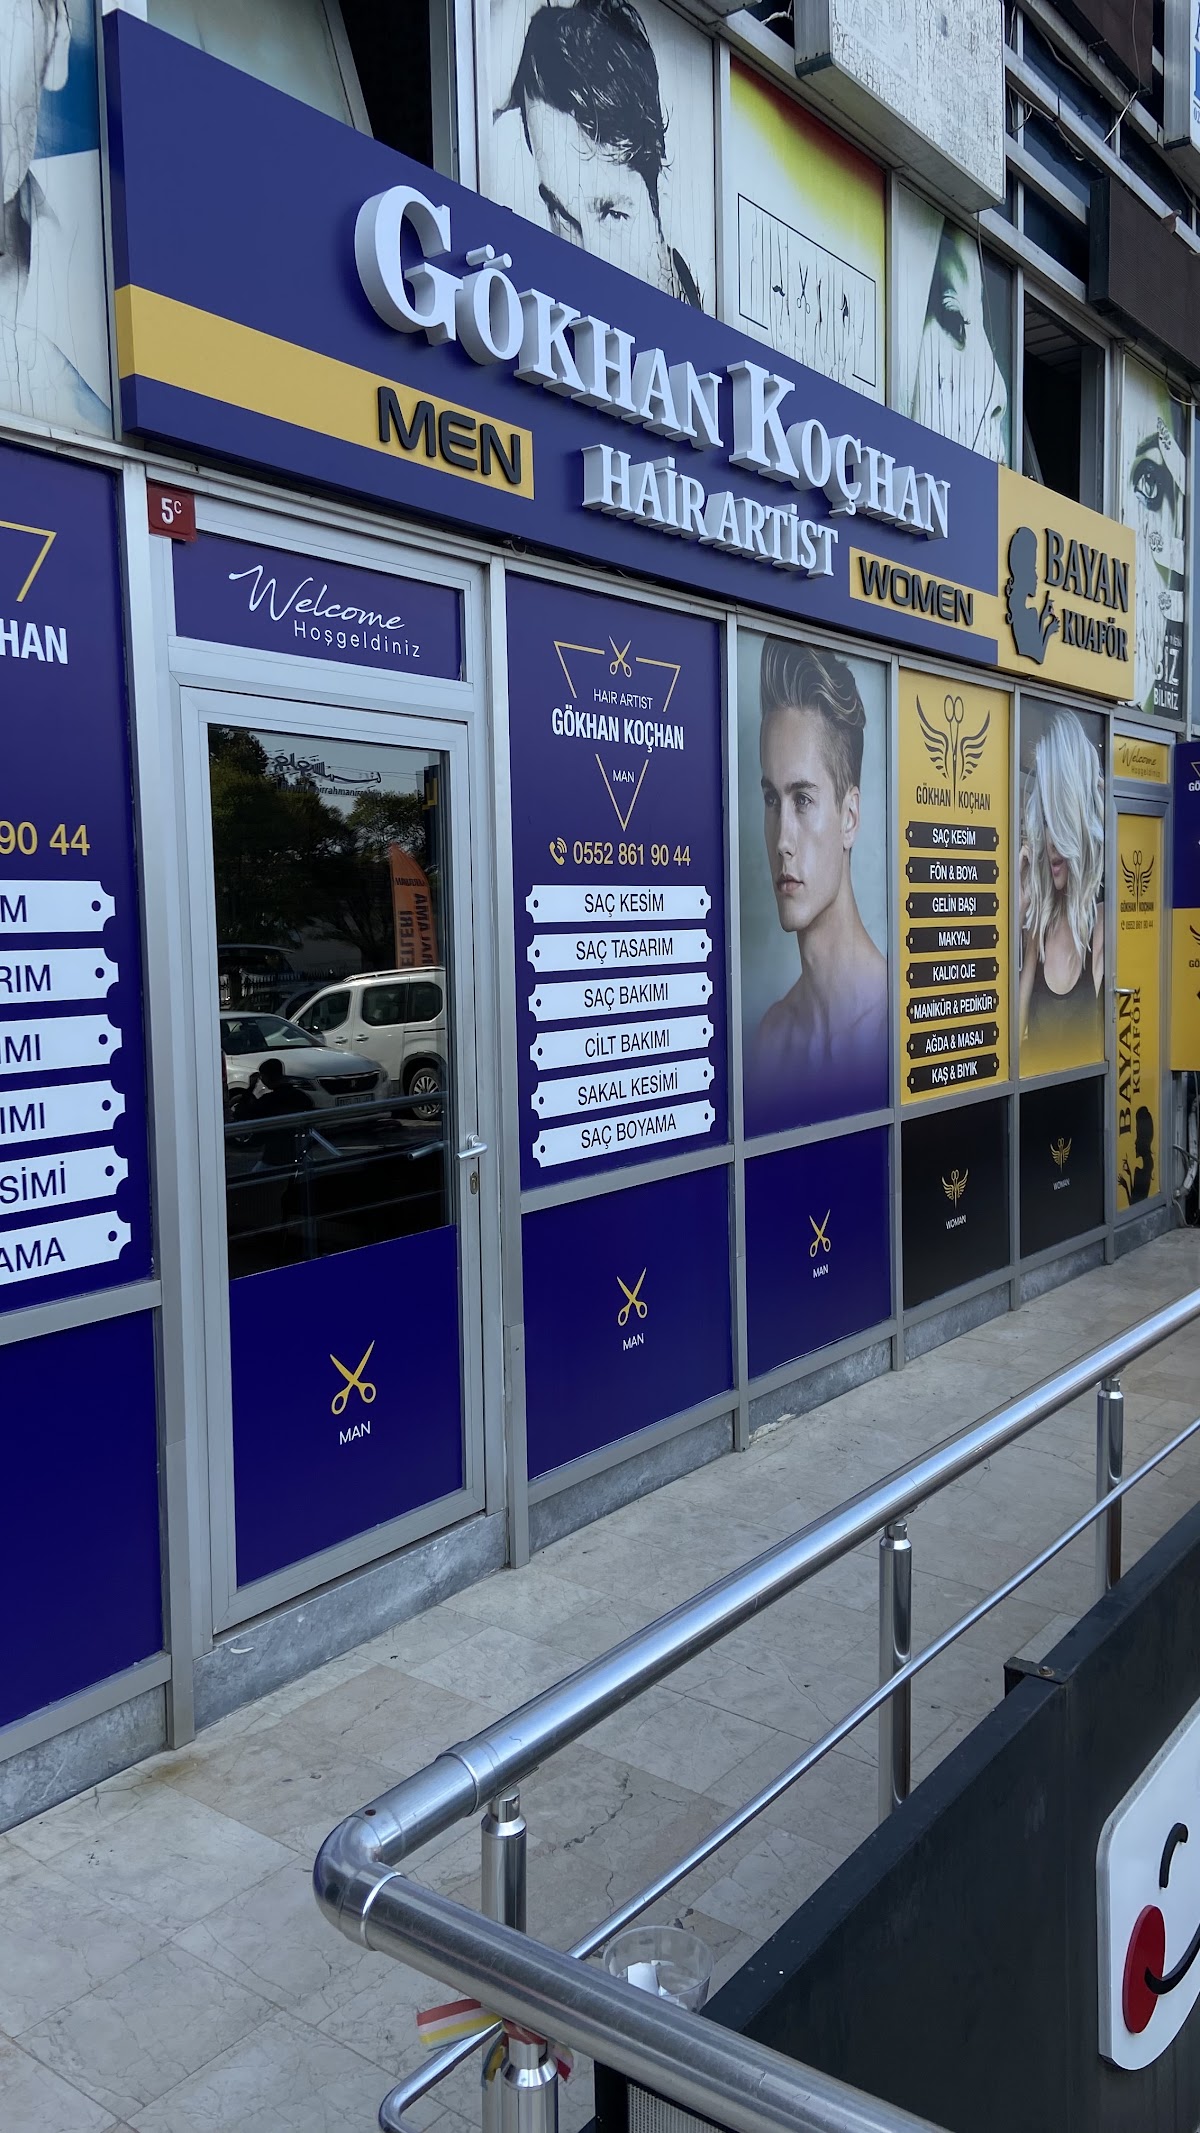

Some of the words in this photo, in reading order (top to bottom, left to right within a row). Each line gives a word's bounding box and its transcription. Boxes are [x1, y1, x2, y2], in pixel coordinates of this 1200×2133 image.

[355, 185, 724, 450] GÖKHAN
[729, 359, 951, 541] KOÇHAN
[378, 386, 521, 485] MEN
[1044, 527, 1130, 613] BAYAN
[228, 564, 406, 630] Welcome
[858, 556, 974, 626] WOMEN
[294, 620, 421, 658] Hoşgeldiniz
[1062, 608, 1129, 662] KUAFÖR
[593, 688, 618, 705] HAIR
[620, 693, 654, 710] ARTIST
[551, 704, 620, 743] GÖKHAN
[624, 718, 684, 753] KOÇHAN
[1118, 742, 1157, 767] Welcome
[613, 770, 635, 783] MAN
[916, 782, 951, 808] GÖKHAN
[958, 790, 991, 814] KOÇHAN
[49, 824, 91, 857] 44
[932, 828, 950, 848] SAÇ
[951, 827, 976, 845] KESİM
[573, 841, 614, 865] 0552
[618, 842, 645, 866] 861
[651, 844, 669, 867] 90
[673, 845, 691, 866] 44
[929, 861, 948, 880] FÖN
[949, 865, 955, 880] &
[956, 865, 978, 880] BOYA
[584, 893, 616, 917] SAÇ
[620, 889, 665, 913] KESİM
[932, 894, 956, 912] GELİN
[958, 897, 977, 915] BAŞI
[576, 940, 608, 964] SAÇ
[611, 938, 674, 959] TASARIM
[938, 930, 971, 946] MAKYAJ
[933, 965, 959, 981] KALICI
[960, 963, 976, 979] OJE
[584, 988, 616, 1011] SAÇ
[619, 982, 669, 1007] BAKIMI
[914, 998, 952, 1019] MANİKÜR
[953, 1000, 959, 1014] &
[960, 993, 993, 1013] PEDİKÜR
[585, 1025, 617, 1058] CİLT
[621, 1029, 670, 1053] BAKIMI
[925, 1034, 949, 1053] AĞDA
[950, 1035, 956, 1049] &
[957, 1030, 984, 1048] MASAJ
[931, 1066, 949, 1085] KAŞ
[949, 1065, 955, 1080] &
[957, 1061, 978, 1079] BIYIK
[578, 1080, 627, 1106] SAKAL
[631, 1067, 679, 1097] KESİMİ
[581, 1126, 612, 1149] SAÇ
[617, 1113, 677, 1141] BOYAMA
[946, 1214, 967, 1230] WOMAN
[812, 1264, 829, 1278] MAN
[622, 1333, 645, 1351] MAN
[339, 1421, 371, 1445] MAN
